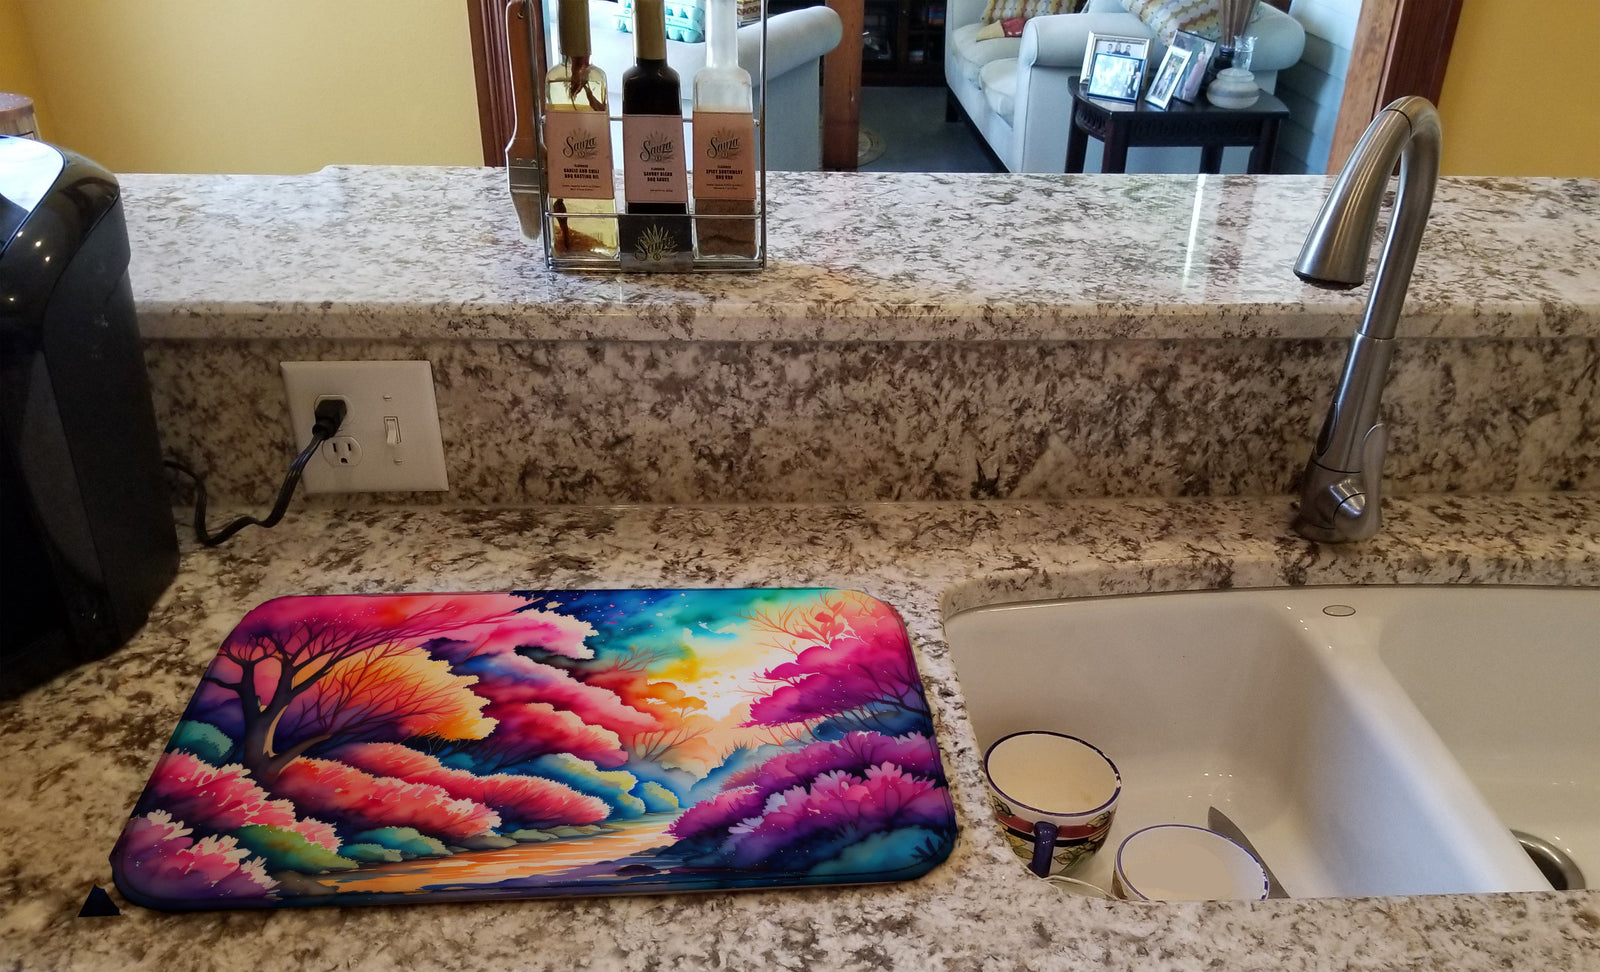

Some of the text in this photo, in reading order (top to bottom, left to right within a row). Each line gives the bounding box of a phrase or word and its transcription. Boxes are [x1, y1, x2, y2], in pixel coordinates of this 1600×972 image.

[563, 136, 598, 158] Sauza
[640, 140, 674, 161] Sauza
[707, 136, 740, 158] Sauza
